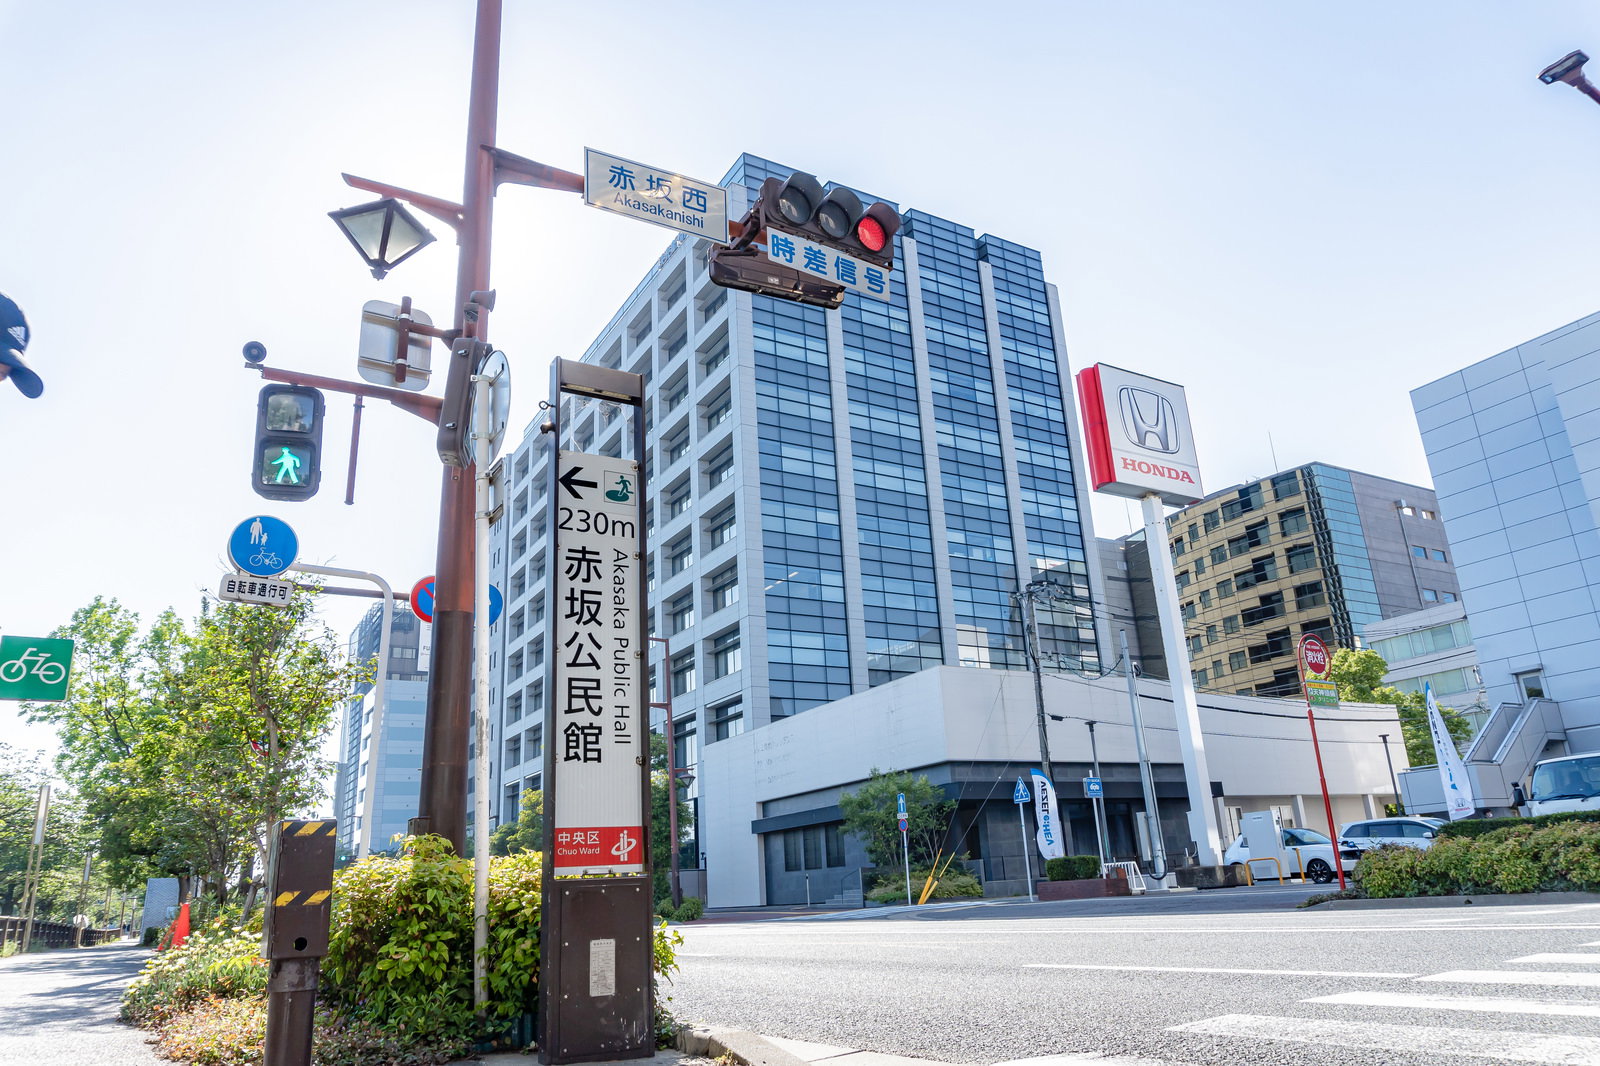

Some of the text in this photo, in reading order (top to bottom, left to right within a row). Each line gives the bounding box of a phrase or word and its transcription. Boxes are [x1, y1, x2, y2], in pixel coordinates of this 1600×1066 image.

[608, 165, 708, 214] 赤坂西
[613, 191, 704, 228] Akasakanishi
[771, 233, 886, 294] 時差信号
[1121, 457, 1195, 484] HONDA
[558, 507, 635, 539] 230m
[226, 579, 288, 600] 自転車通行可
[563, 546, 604, 763] 赤坂公民館
[612, 547, 632, 745] Akasaka Public Hall
[557, 847, 600, 856] Chuo Ward
[558, 831, 600, 846] 中央区
